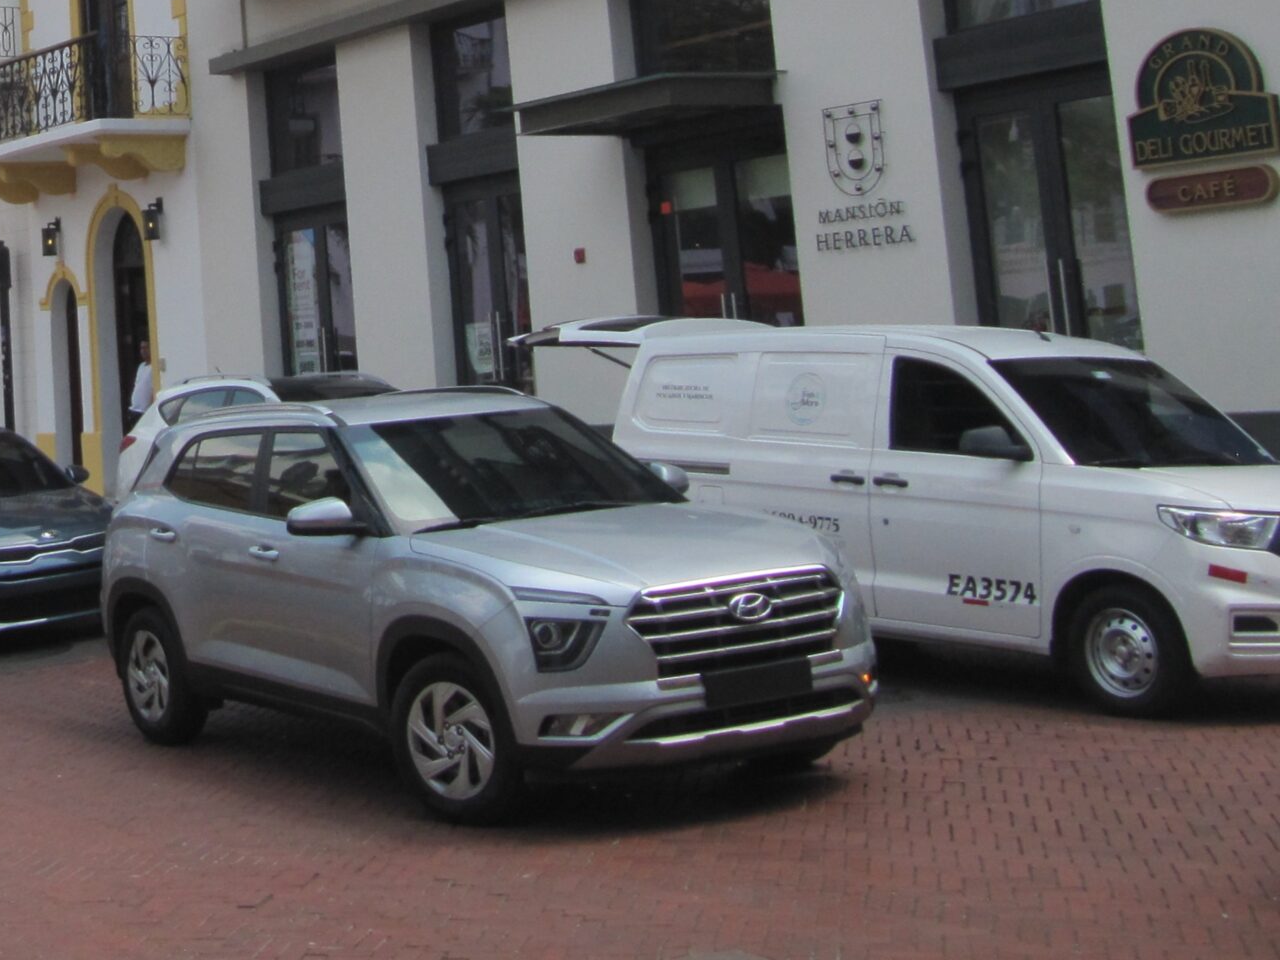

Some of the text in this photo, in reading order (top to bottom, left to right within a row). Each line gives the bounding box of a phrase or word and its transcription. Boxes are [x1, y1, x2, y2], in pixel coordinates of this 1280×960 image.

[1148, 34, 1229, 69] GRAND
[1136, 123, 1269, 161] DELI GOURMET
[1177, 174, 1236, 202] CAFÉ
[816, 225, 915, 251] HERRERA
[946, 574, 1037, 604] EA3574
